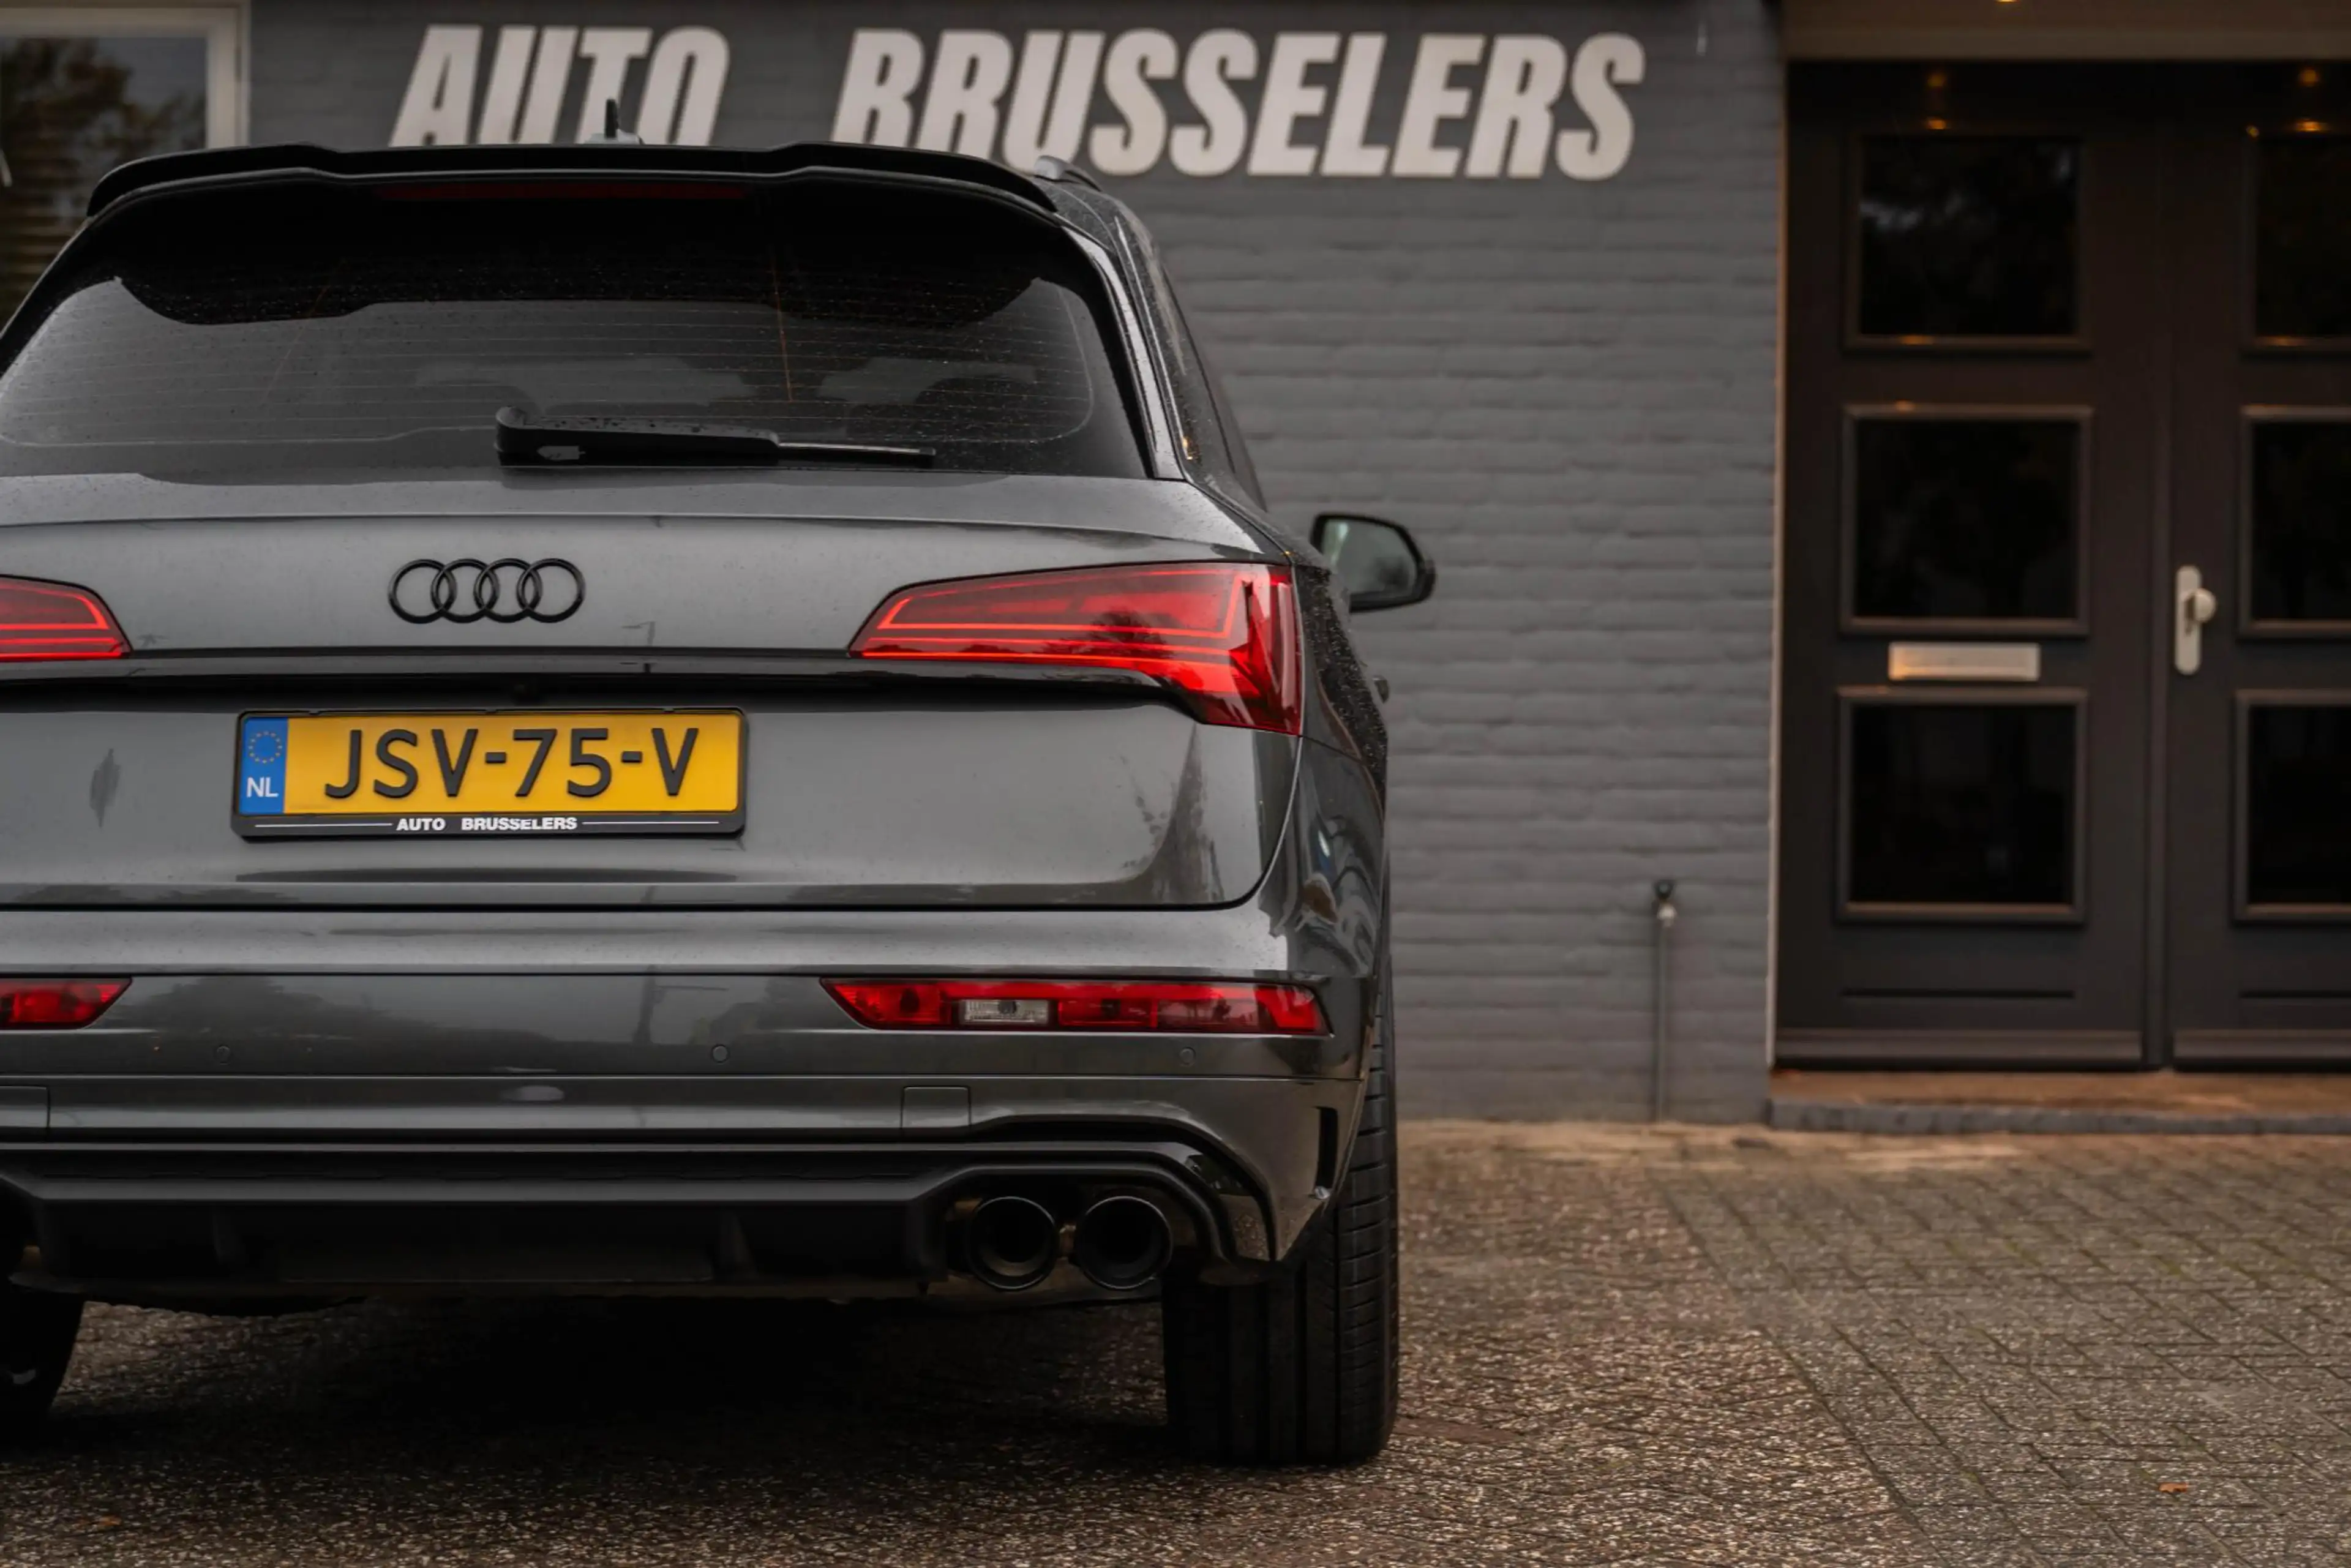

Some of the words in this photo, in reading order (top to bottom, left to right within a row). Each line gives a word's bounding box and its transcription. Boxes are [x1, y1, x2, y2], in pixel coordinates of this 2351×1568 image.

[388, 24, 730, 147] AUTO
[832, 29, 1646, 180] BRUSSELERS
[324, 728, 699, 798] JSV-75-V
[247, 777, 279, 798] NL
[396, 818, 446, 831] AUTO
[461, 817, 577, 830] BRUSSELERS
